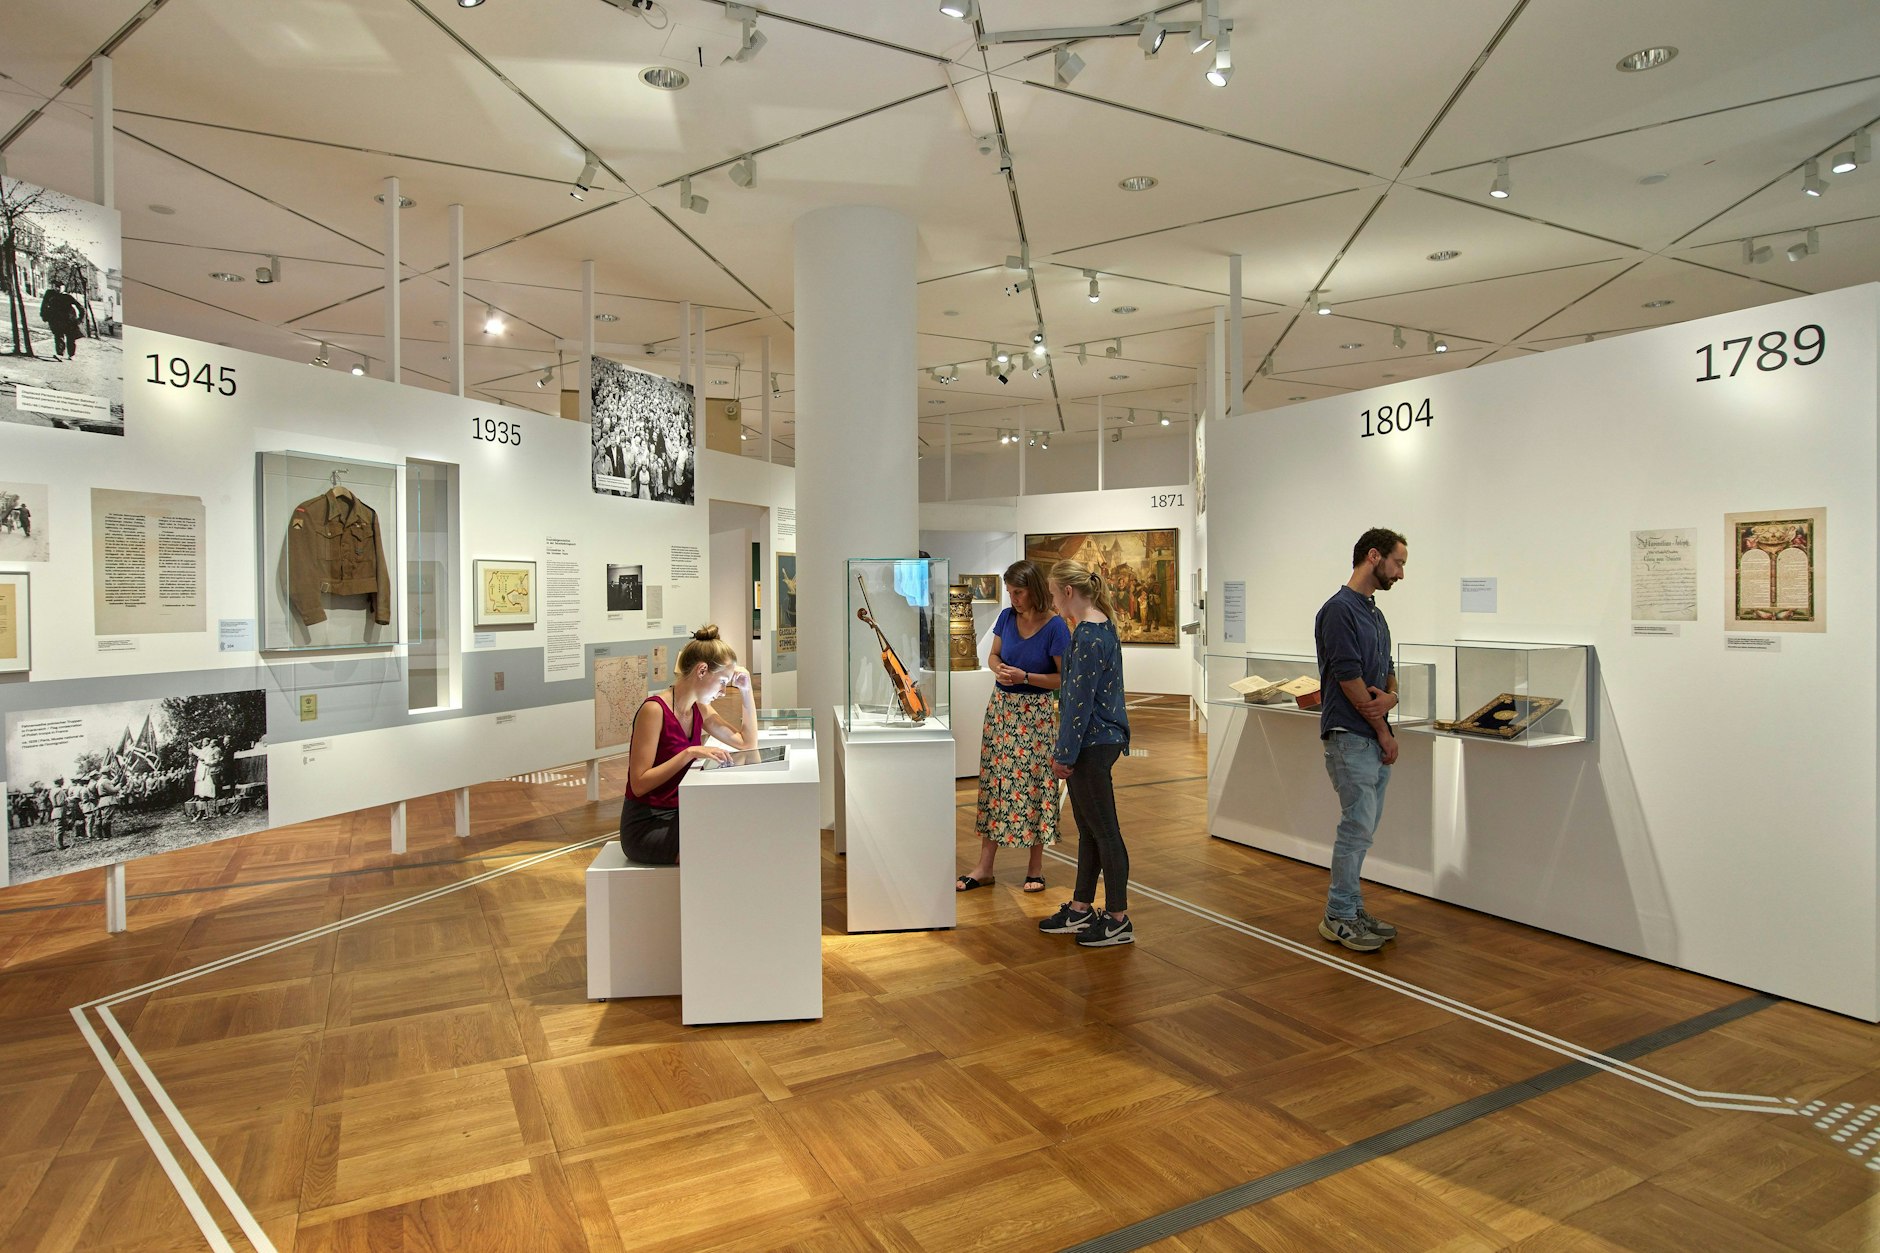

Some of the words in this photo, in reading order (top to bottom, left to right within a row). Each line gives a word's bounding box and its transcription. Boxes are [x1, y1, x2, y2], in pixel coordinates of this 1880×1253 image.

[1695, 323, 1826, 383] 1789
[146, 353, 237, 397] 1945
[472, 417, 521, 446] 1935
[1360, 397, 1434, 438] 1804
[1151, 493, 1185, 508] 1871
